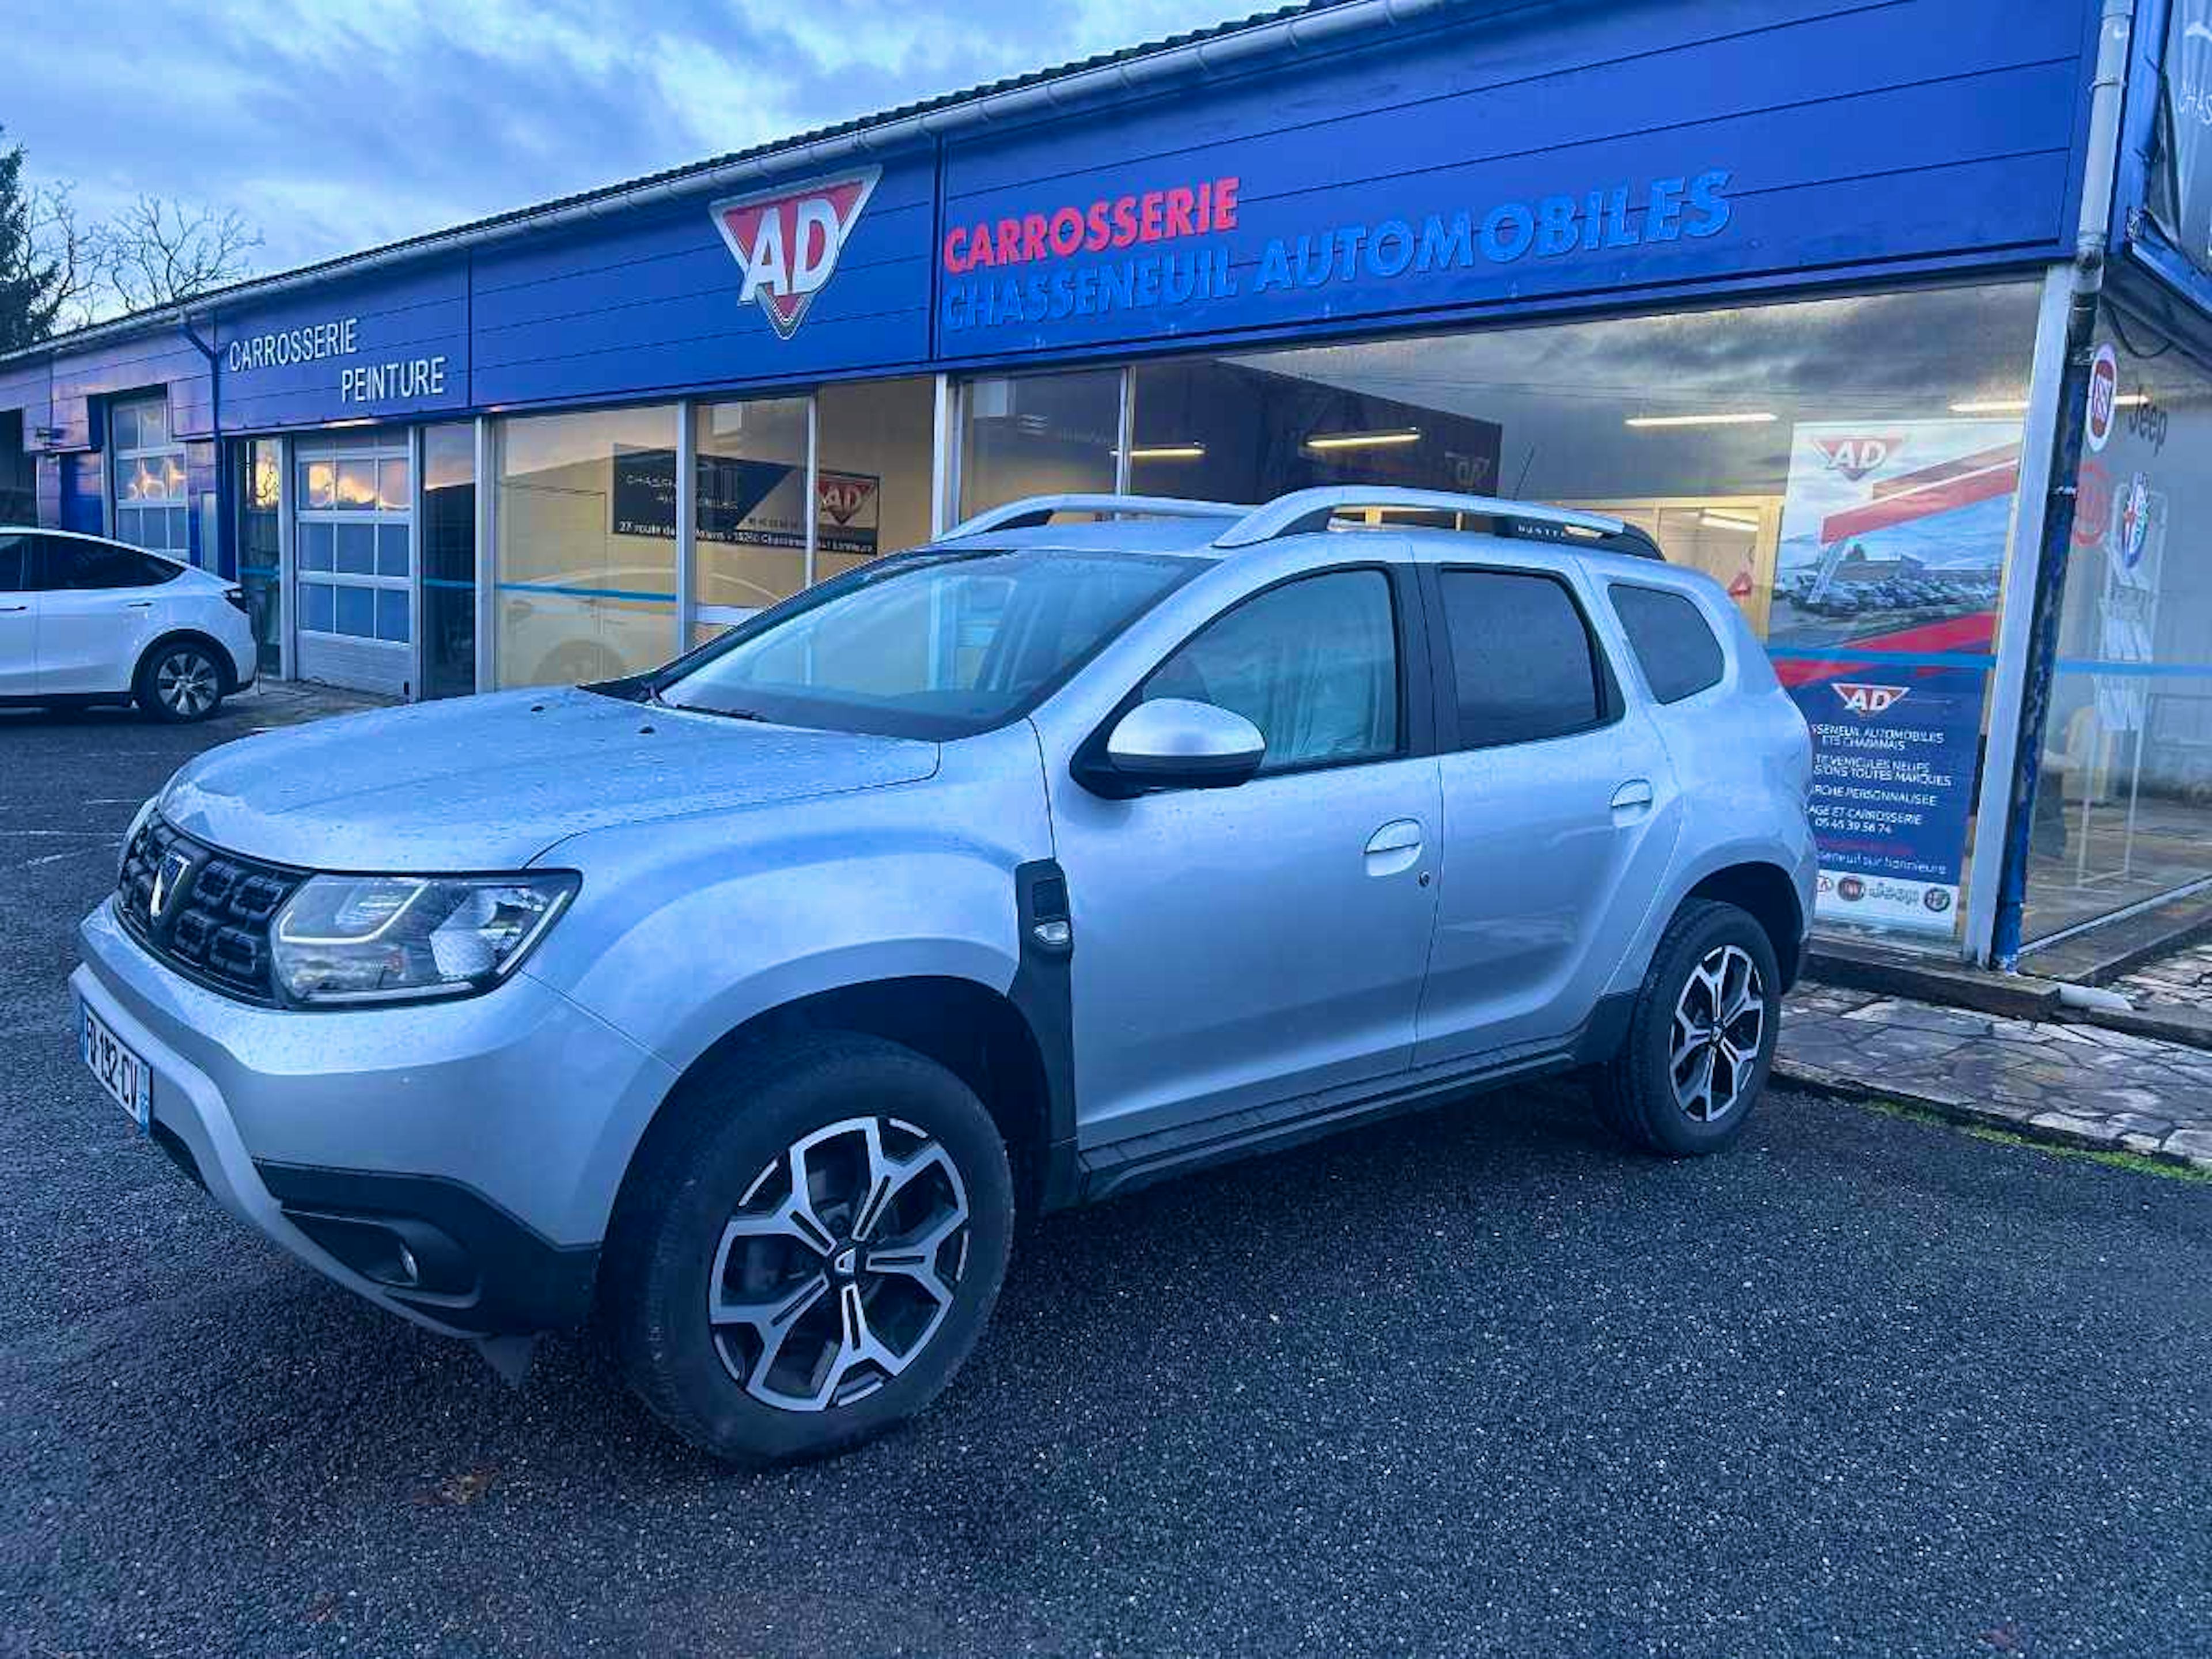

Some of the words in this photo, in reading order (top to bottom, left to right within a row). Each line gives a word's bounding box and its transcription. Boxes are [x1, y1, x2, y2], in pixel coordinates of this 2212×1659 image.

[941, 246, 1238, 332] CHASSENEUIL
[1253, 168, 1732, 294] AUTOMOBILES
[944, 176, 1241, 274] CARROSSERIE
[737, 197, 840, 306] AD
[229, 318, 358, 373] CARROSSERIE
[341, 356, 445, 403] PEINTURE
[2128, 385, 2168, 457] Jeep
[1827, 440, 1886, 471] AD
[1843, 689, 1892, 711] AD
[1851, 768, 1892, 781] TOUTES
[1894, 771, 1952, 786] MARQUES
[1846, 808, 1923, 825] CARROSSERIE
